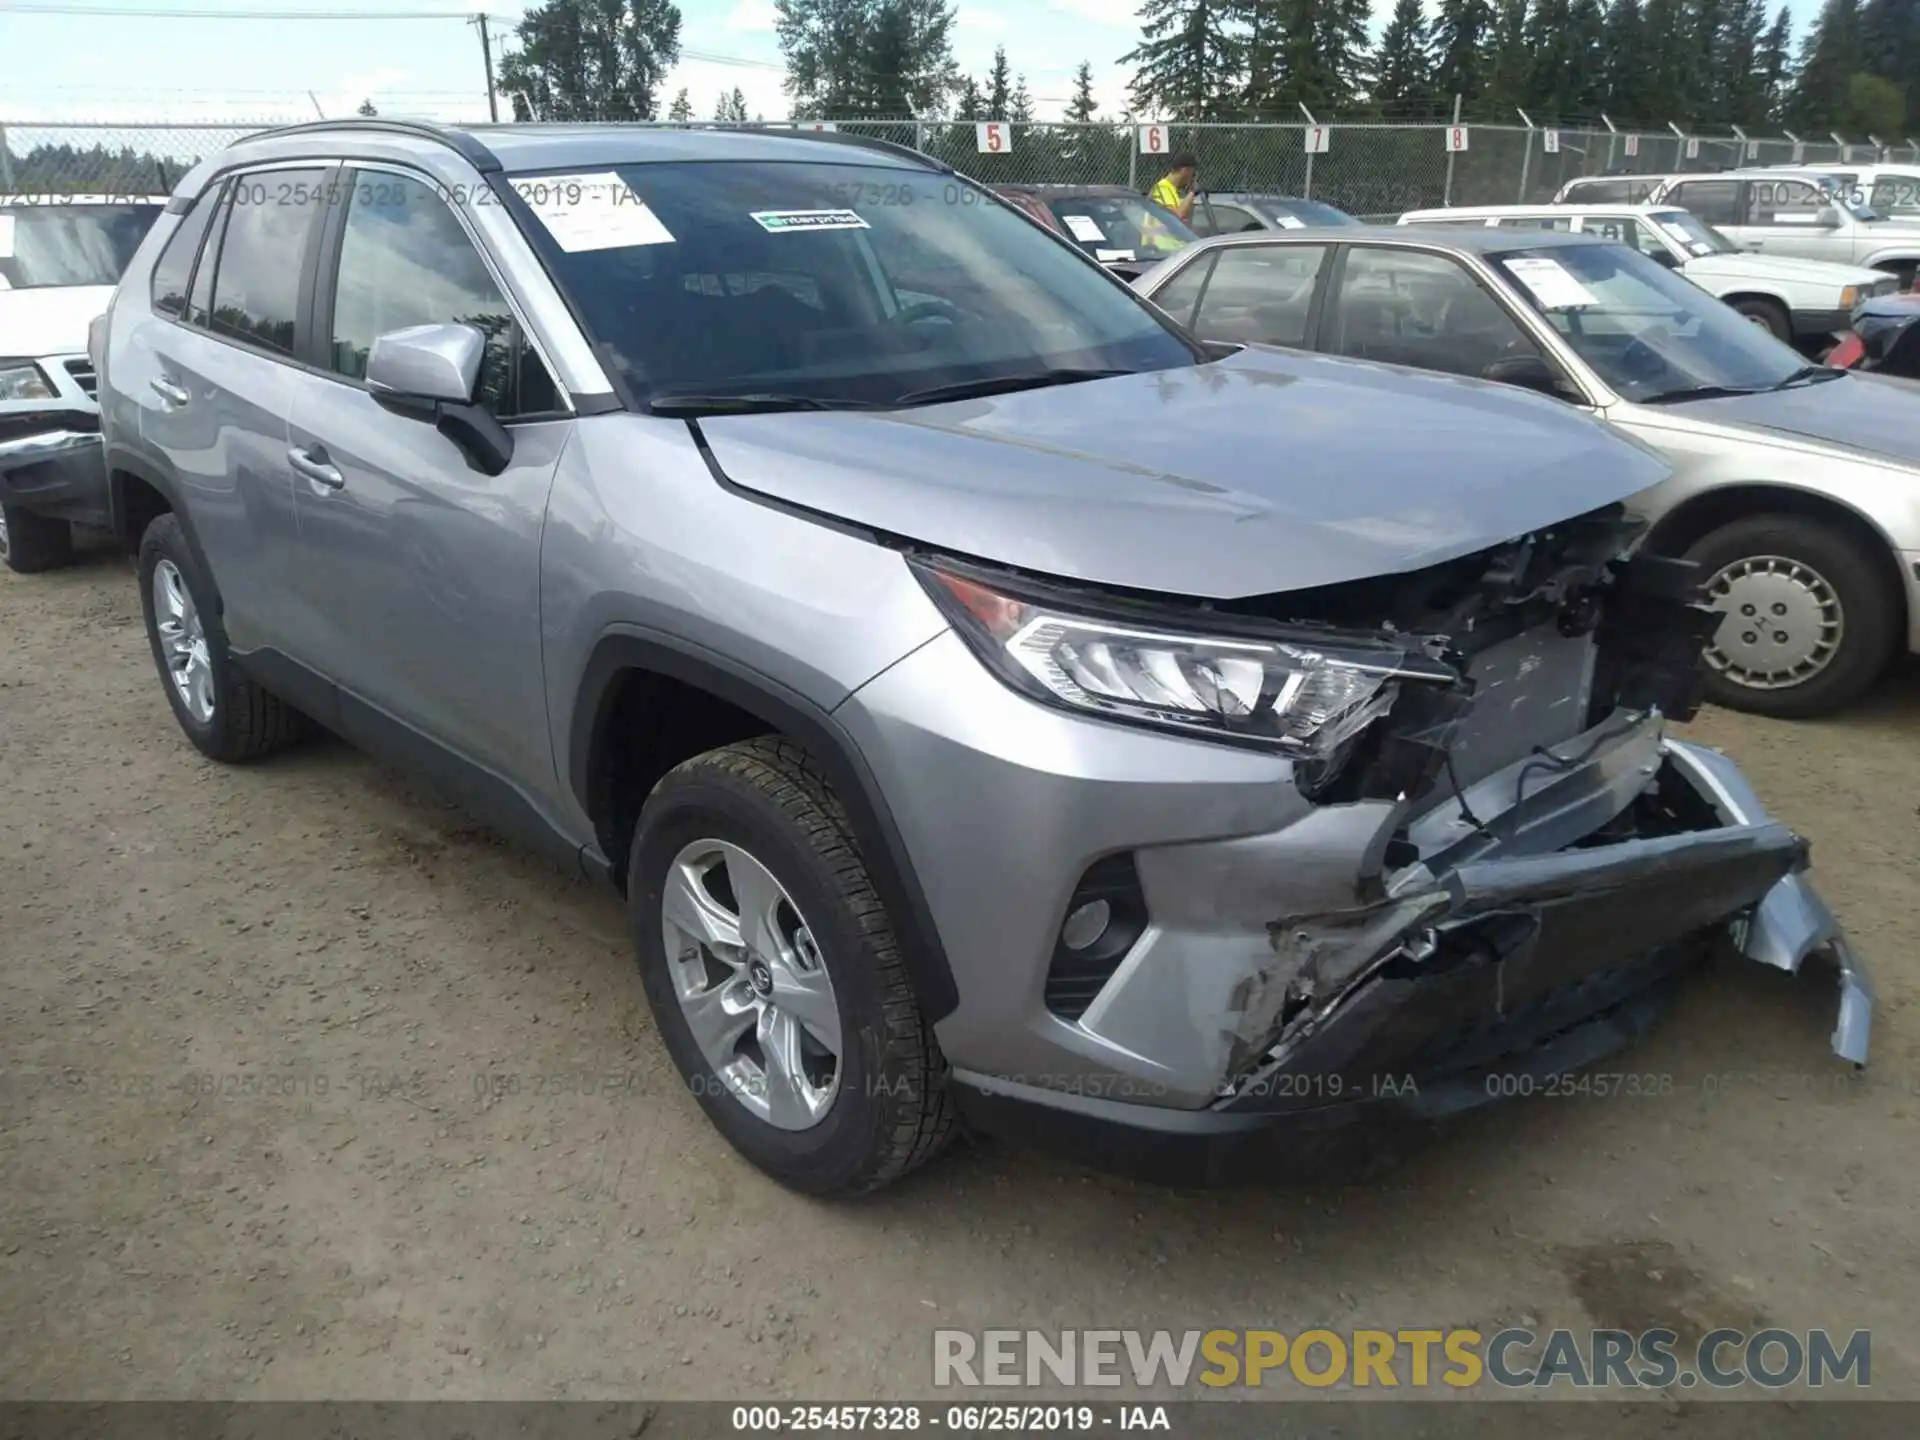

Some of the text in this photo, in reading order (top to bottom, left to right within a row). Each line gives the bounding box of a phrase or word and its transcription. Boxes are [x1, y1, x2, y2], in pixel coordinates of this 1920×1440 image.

[987, 114, 1001, 152] 5
[1149, 127, 1161, 152] 6
[1314, 128, 1322, 151] 7
[1453, 129, 1461, 149] 8
